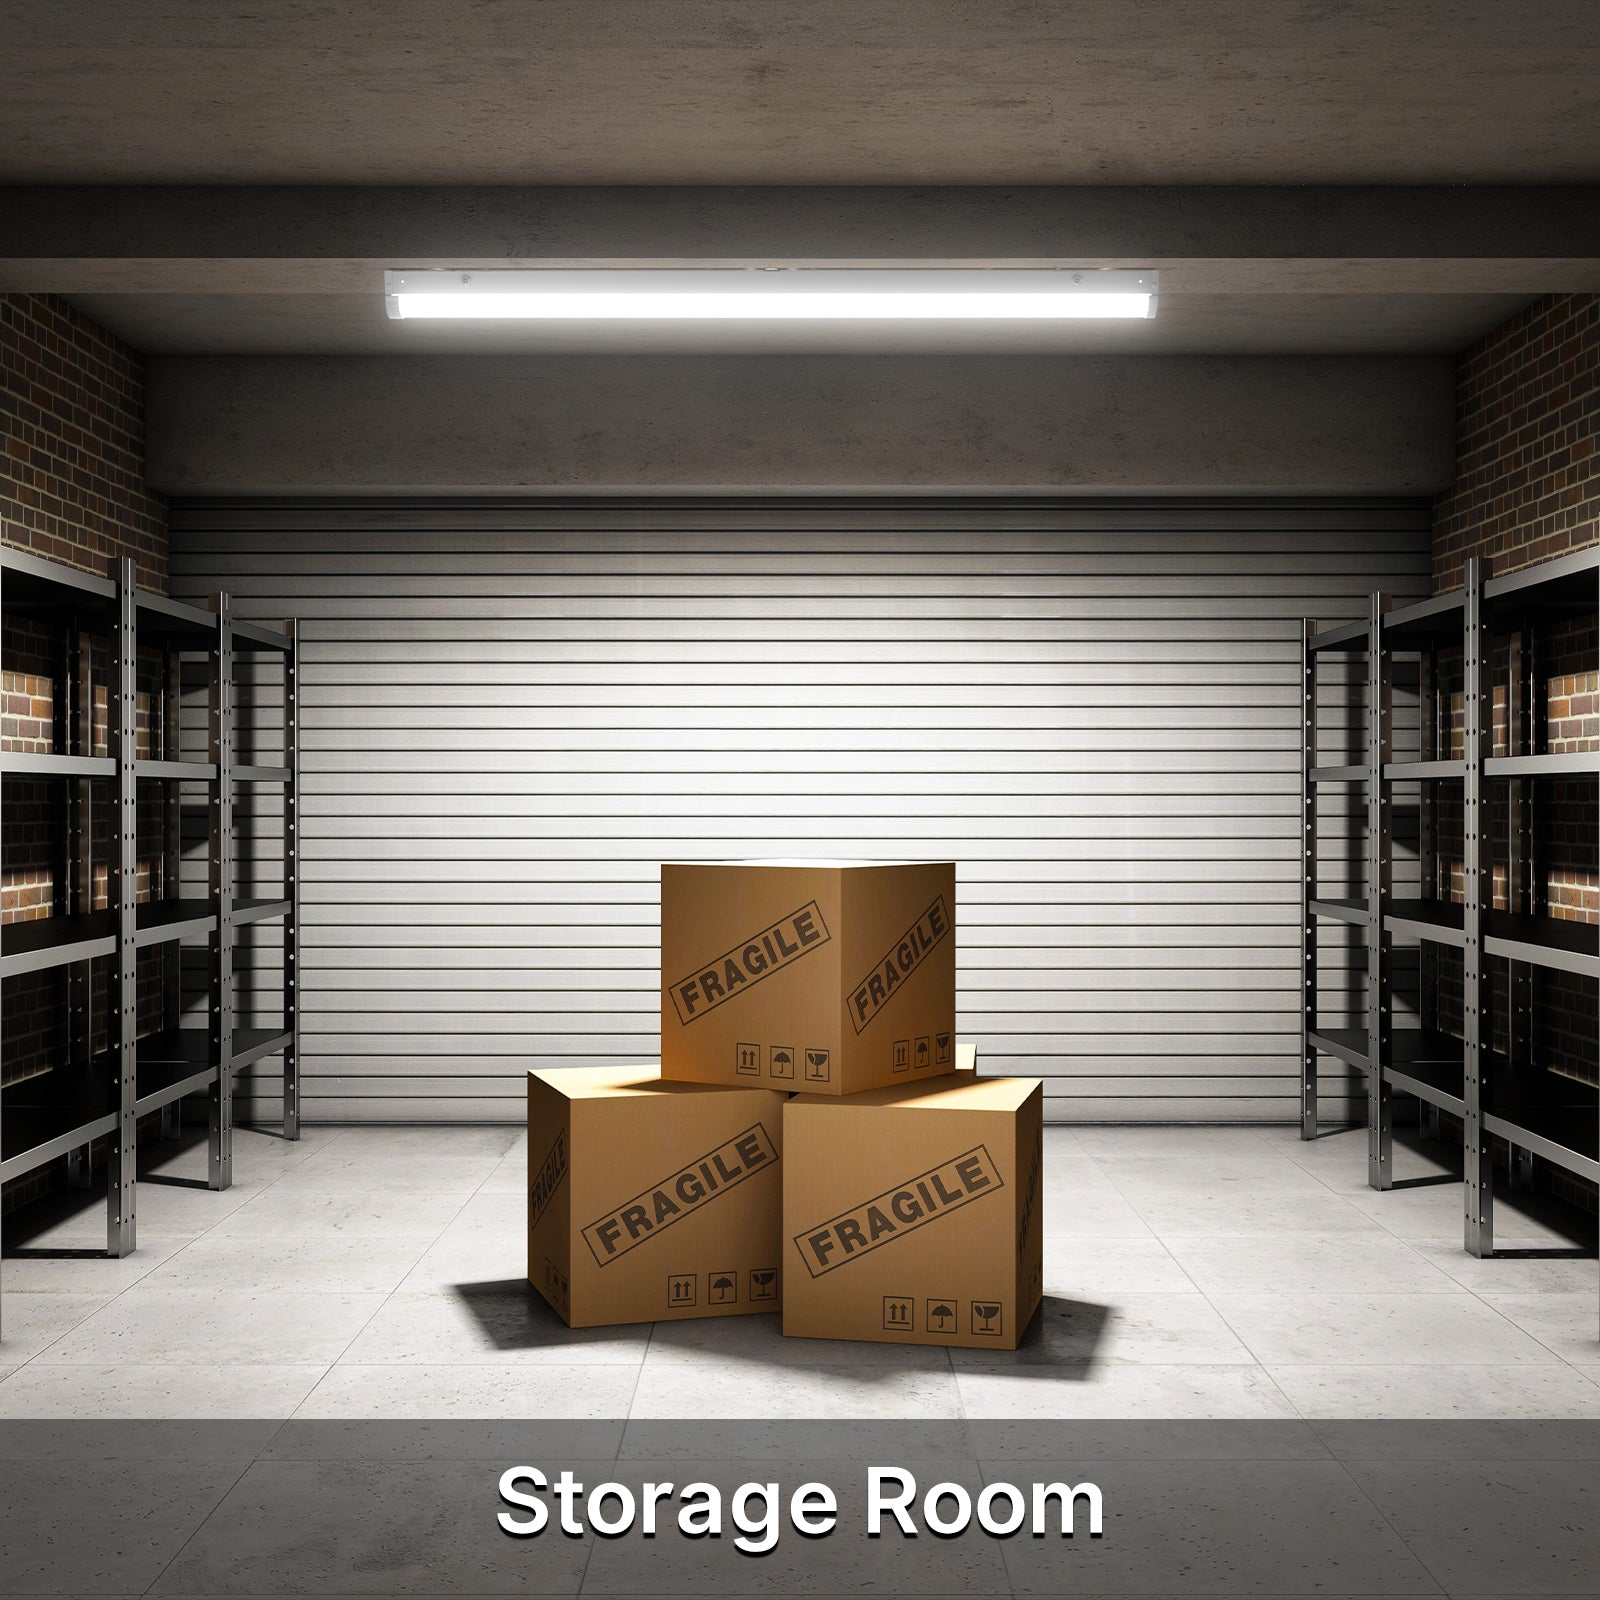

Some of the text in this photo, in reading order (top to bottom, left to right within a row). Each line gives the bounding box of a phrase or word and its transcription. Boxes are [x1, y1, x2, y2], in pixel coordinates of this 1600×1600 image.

[679, 911, 821, 1014] FRAGILE
[857, 906, 946, 1021] FRAGILE
[531, 1138, 567, 1221] FRAGILE
[595, 1134, 768, 1256] FRAGILE
[808, 1155, 991, 1266] FRAGILE
